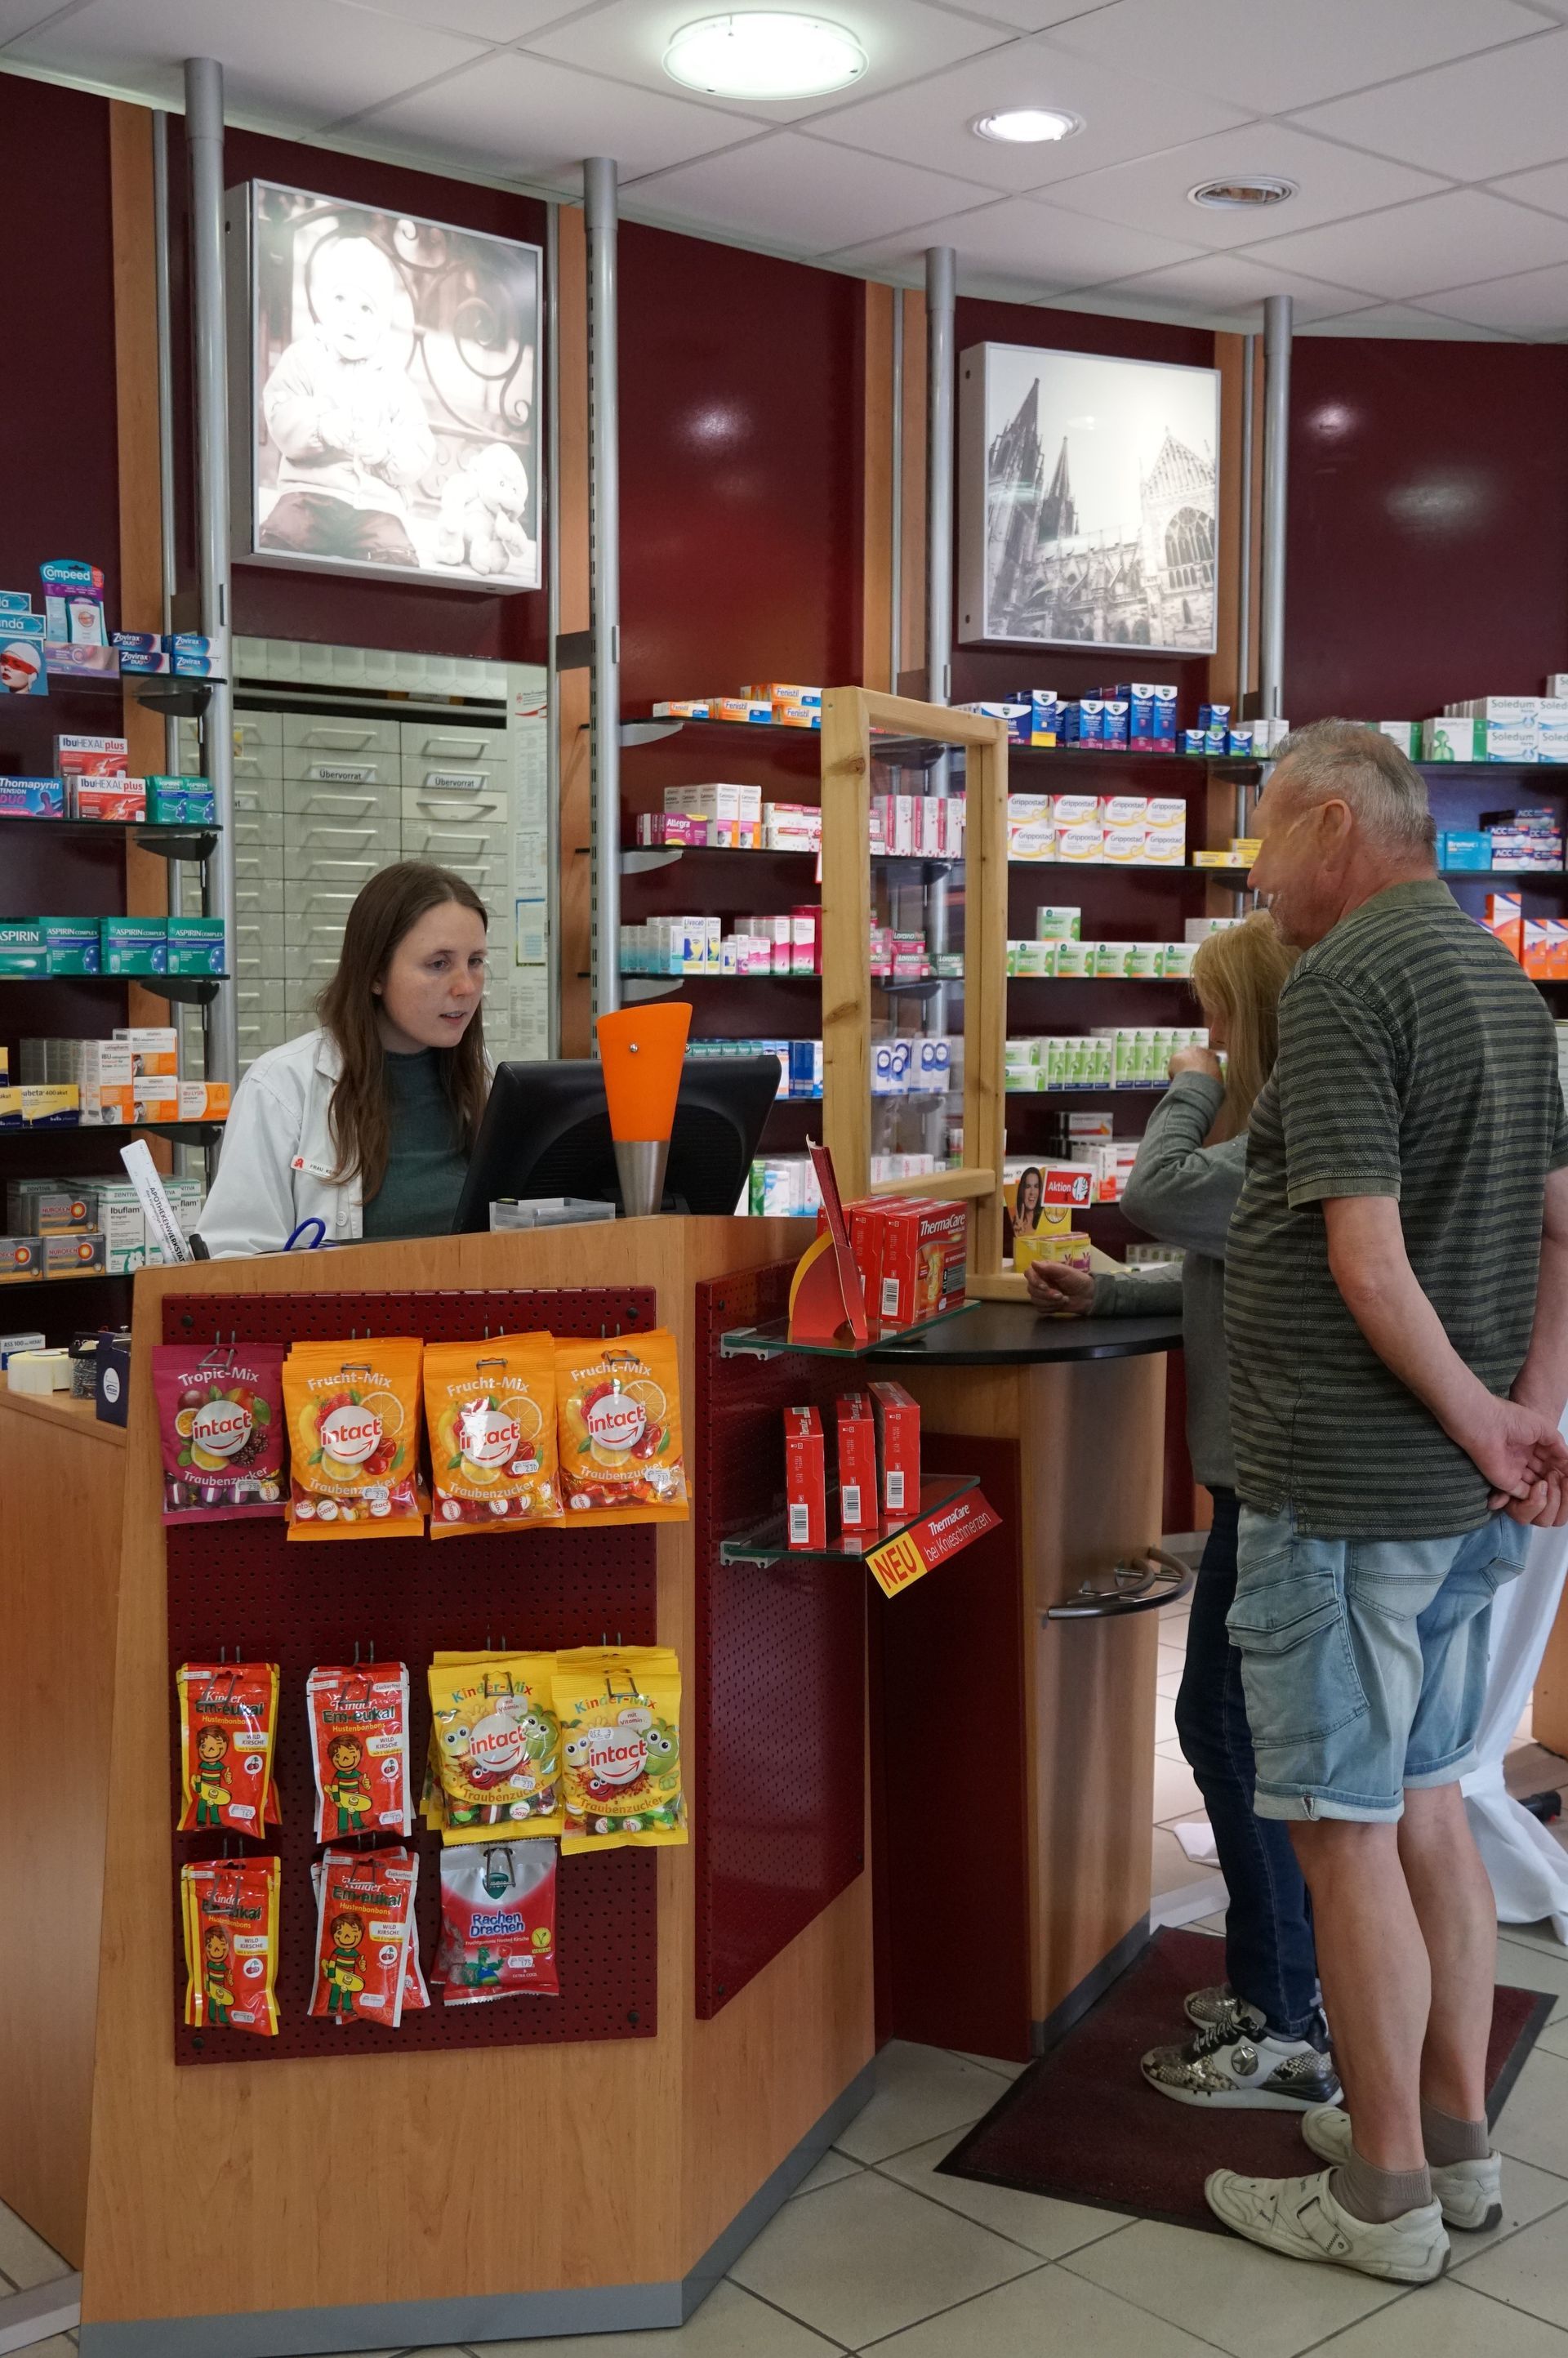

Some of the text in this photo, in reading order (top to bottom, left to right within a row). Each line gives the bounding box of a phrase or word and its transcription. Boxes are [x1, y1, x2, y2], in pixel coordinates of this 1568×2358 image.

[43, 565, 91, 581] Compeed
[113, 632, 140, 643] Zovirax
[176, 636, 199, 646] Zovirax
[121, 651, 149, 662] Zovirax
[176, 656, 201, 666] Zovirax
[777, 688, 799, 697] Fenistil
[725, 702, 747, 711] Fenistil
[1492, 699, 1535, 709] Soledum
[1540, 701, 1568, 710] Soled
[787, 708, 809, 717] Fenistil
[1492, 733, 1535, 742] Soledum
[1543, 733, 1568, 742] Soled
[63, 738, 125, 752] IbuHEXAL plus
[319, 769, 362, 781] Übervorrat
[0, 778, 59, 791] Thomapyrin
[82, 778, 143, 793] IbuHEXAL plus
[434, 777, 474, 788] Übervorrat
[0, 794, 27, 805] DUO
[1012, 798, 1045, 807] Grippostad
[1062, 800, 1095, 809] Grippostad
[1112, 801, 1144, 809] Grippostad
[666, 819, 690, 829] Allegra
[1018, 832, 1053, 841] Grippostad
[1067, 833, 1101, 842] Grippostad
[1111, 835, 1143, 844] Grippostad
[1151, 836, 1183, 844] Grippostad
[310, 1164, 323, 1172] FRAU
[1048, 1181, 1071, 1192] Aktion
[180, 1199, 198, 1207] flam
[920, 1214, 965, 1237] ThermaCare
[178, 1367, 259, 1386] Tropic-Mix
[570, 1362, 652, 1382] Frucht-Mix
[307, 1371, 392, 1391] Frucht-Mix
[447, 1376, 529, 1397] Frucht-Mix
[194, 1411, 252, 1440] intact
[588, 1406, 646, 1434] intact
[321, 1418, 381, 1446] intact
[450, 1479, 535, 1499] Traubenzucker
[929, 1504, 969, 1536] ThermaCare
[924, 1512, 991, 1562] bei Knieschmerzen
[874, 1540, 917, 1589] NEU
[452, 1683, 533, 1703] Kinder-Mix
[498, 1705, 519, 1713] Vitamin
[574, 1694, 657, 1714] Kinder-Mix
[323, 1705, 395, 1724] Em-eukal
[332, 1723, 385, 1732] Hustenbonbons
[471, 1726, 527, 1755] intact
[590, 1739, 648, 1767] intact
[579, 1797, 663, 1815] Traubenzucker
[333, 1885, 401, 1907] Em-eukal
[340, 1902, 391, 1915] Hustenbonbons
[473, 1910, 522, 1926] Rachen
[470, 1922, 524, 1937] Drachen
